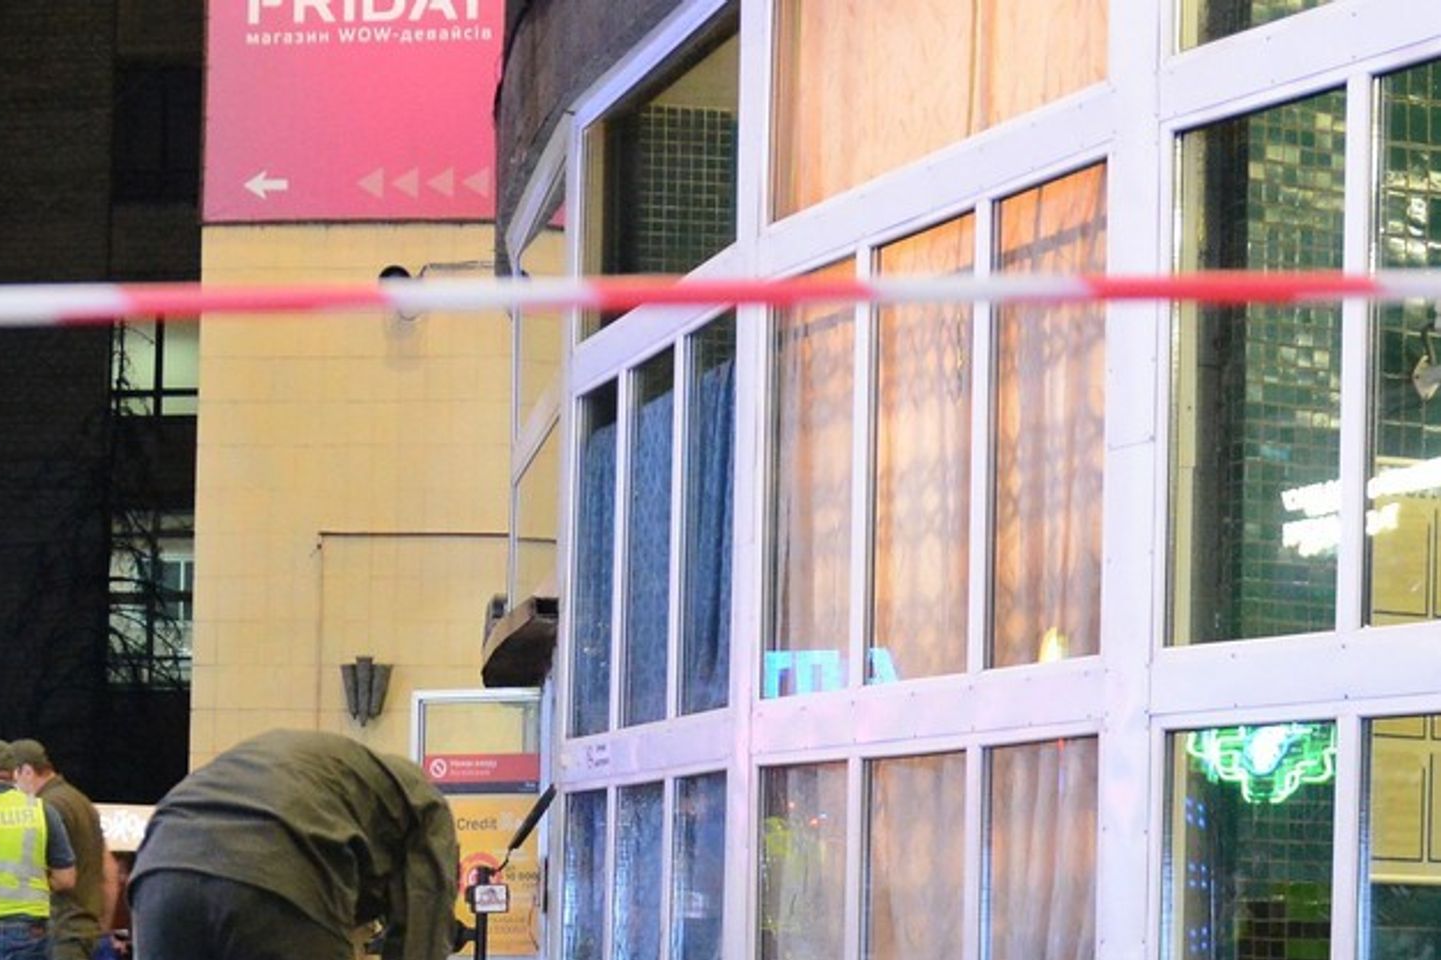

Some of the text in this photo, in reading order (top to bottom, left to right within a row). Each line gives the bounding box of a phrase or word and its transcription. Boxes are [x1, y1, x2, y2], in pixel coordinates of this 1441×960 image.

[246, 25, 493, 45] магазин WOW-девайсів
[456, 817, 498, 832] Credit
